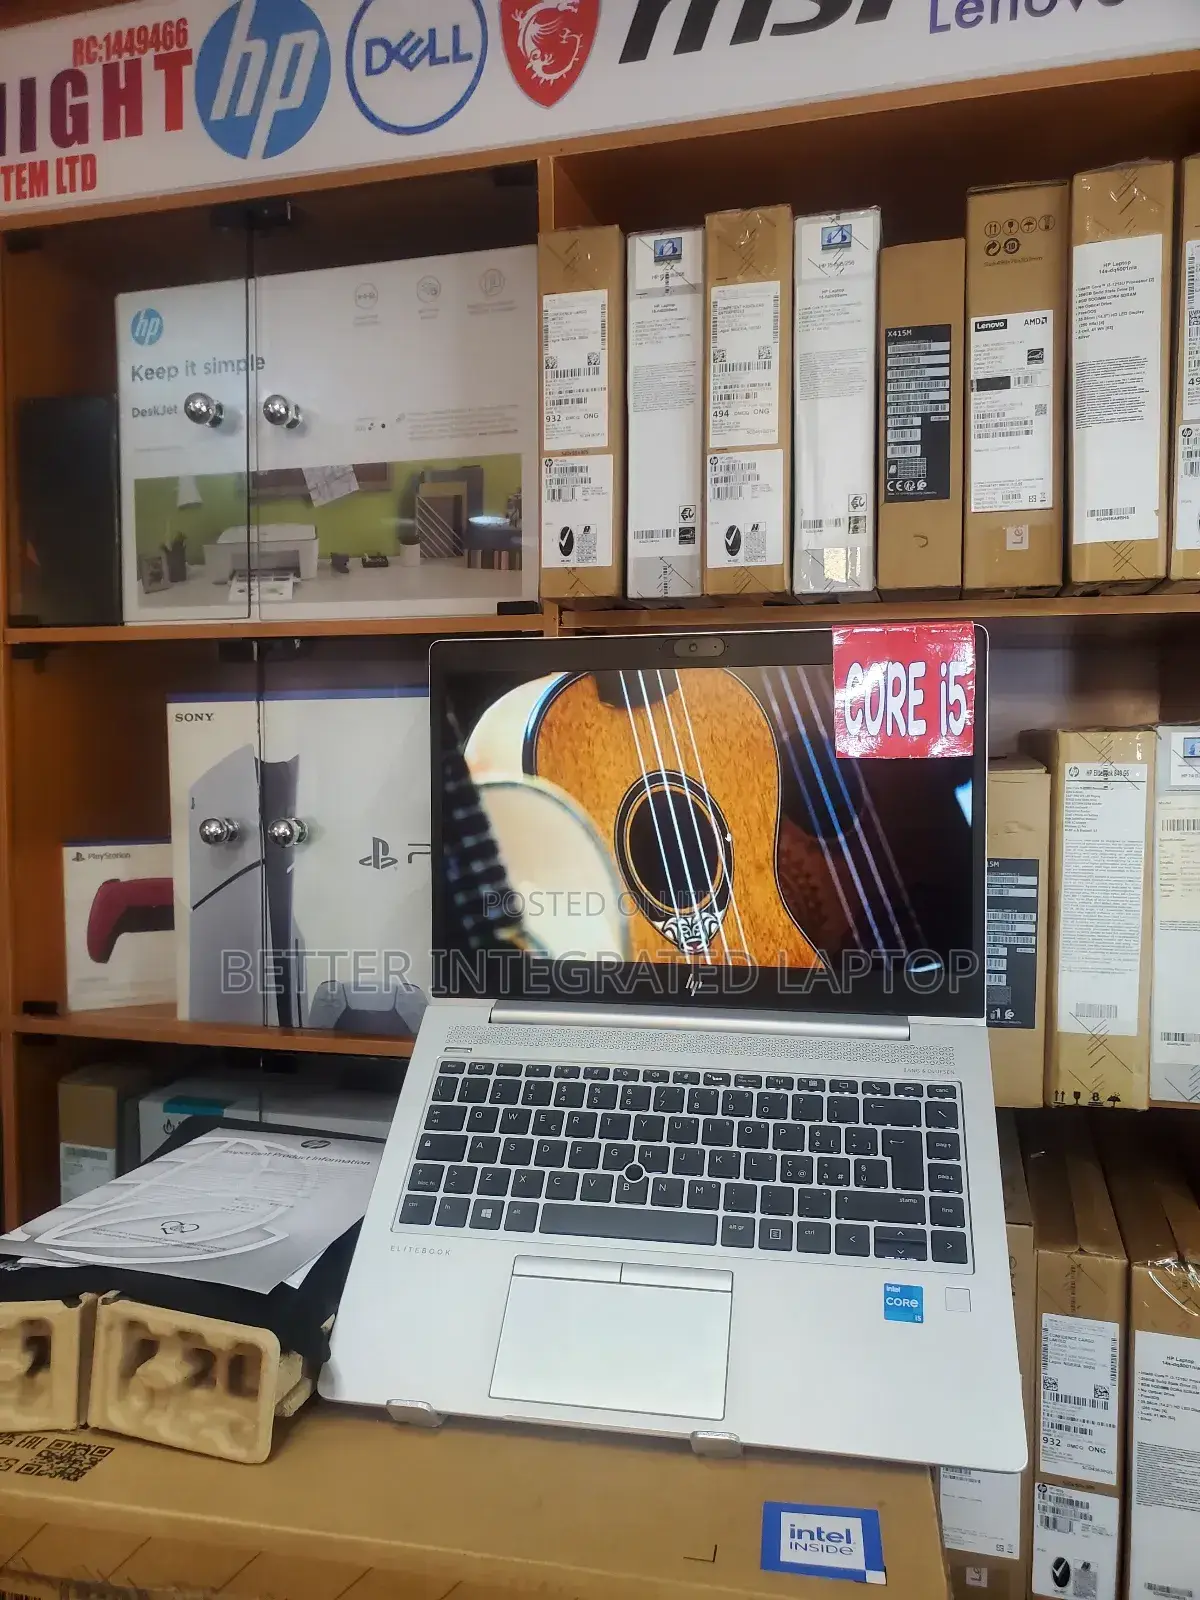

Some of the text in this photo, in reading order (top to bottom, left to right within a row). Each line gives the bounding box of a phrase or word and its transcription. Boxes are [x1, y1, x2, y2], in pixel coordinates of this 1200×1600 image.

[929, 0, 1123, 35] Leno
[72, 18, 189, 67] RC:1449466
[365, 24, 473, 76] DELL
[56, 153, 97, 195] LTD
[977, 321, 1004, 329] Lenovo
[1024, 318, 1041, 326] AMD
[131, 354, 266, 386] Keep it simple
[131, 403, 178, 419] DeskJet
[712, 410, 729, 418] 494
[844, 660, 968, 737] CORE i5
[175, 713, 214, 723] SONY
[88, 852, 131, 861] PlayStation
[272, 1152, 311, 1161] Product
[312, 1156, 370, 1165] Information
[390, 1245, 452, 1256] ELITEBOOK
[1042, 1436, 1061, 1446] 932
[1088, 1446, 1106, 1454] ONG
[789, 1524, 852, 1544] intel
